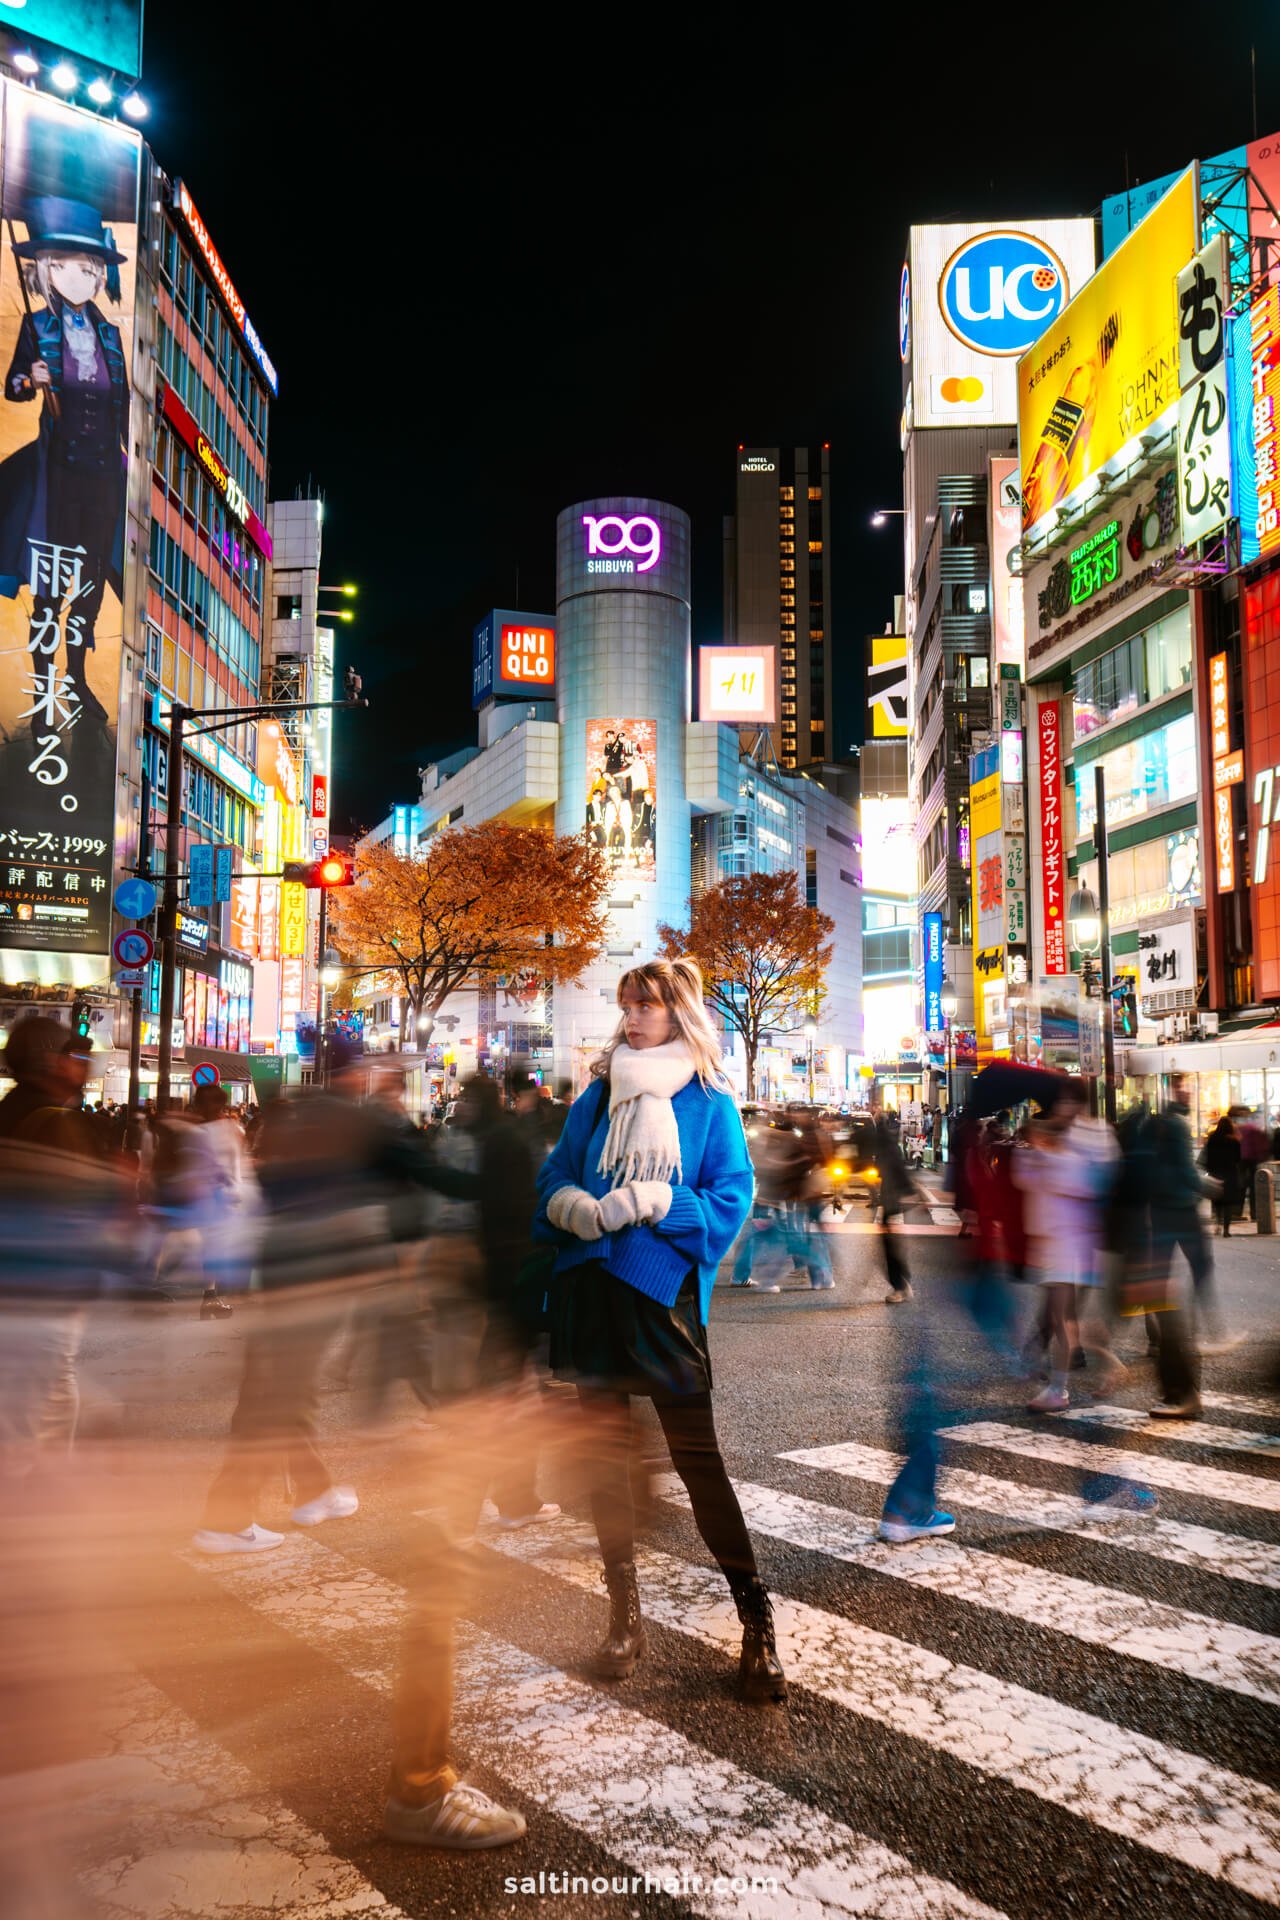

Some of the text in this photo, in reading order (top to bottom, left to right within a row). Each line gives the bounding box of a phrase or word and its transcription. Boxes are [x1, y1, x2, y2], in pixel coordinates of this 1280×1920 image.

[1180, 263, 1230, 517] もんじゃ
[1250, 300, 1278, 538] 三千里薬品
[741, 463, 775, 472] INDIGO
[583, 516, 661, 572] 109
[587, 560, 634, 573] SHIBUYA
[1071, 538, 1119, 605] 西村
[507, 631, 545, 654] UNI
[17, 537, 96, 813] 雨が来る。
[507, 655, 549, 678] QLO
[1043, 729, 1060, 903] ウィンターフルーツギフト
[8, 868, 106, 893] 評配信中
[1008, 904, 1016, 931] フルーツ
[930, 923, 939, 962] MIZUHO
[220, 960, 249, 998] LUSH
